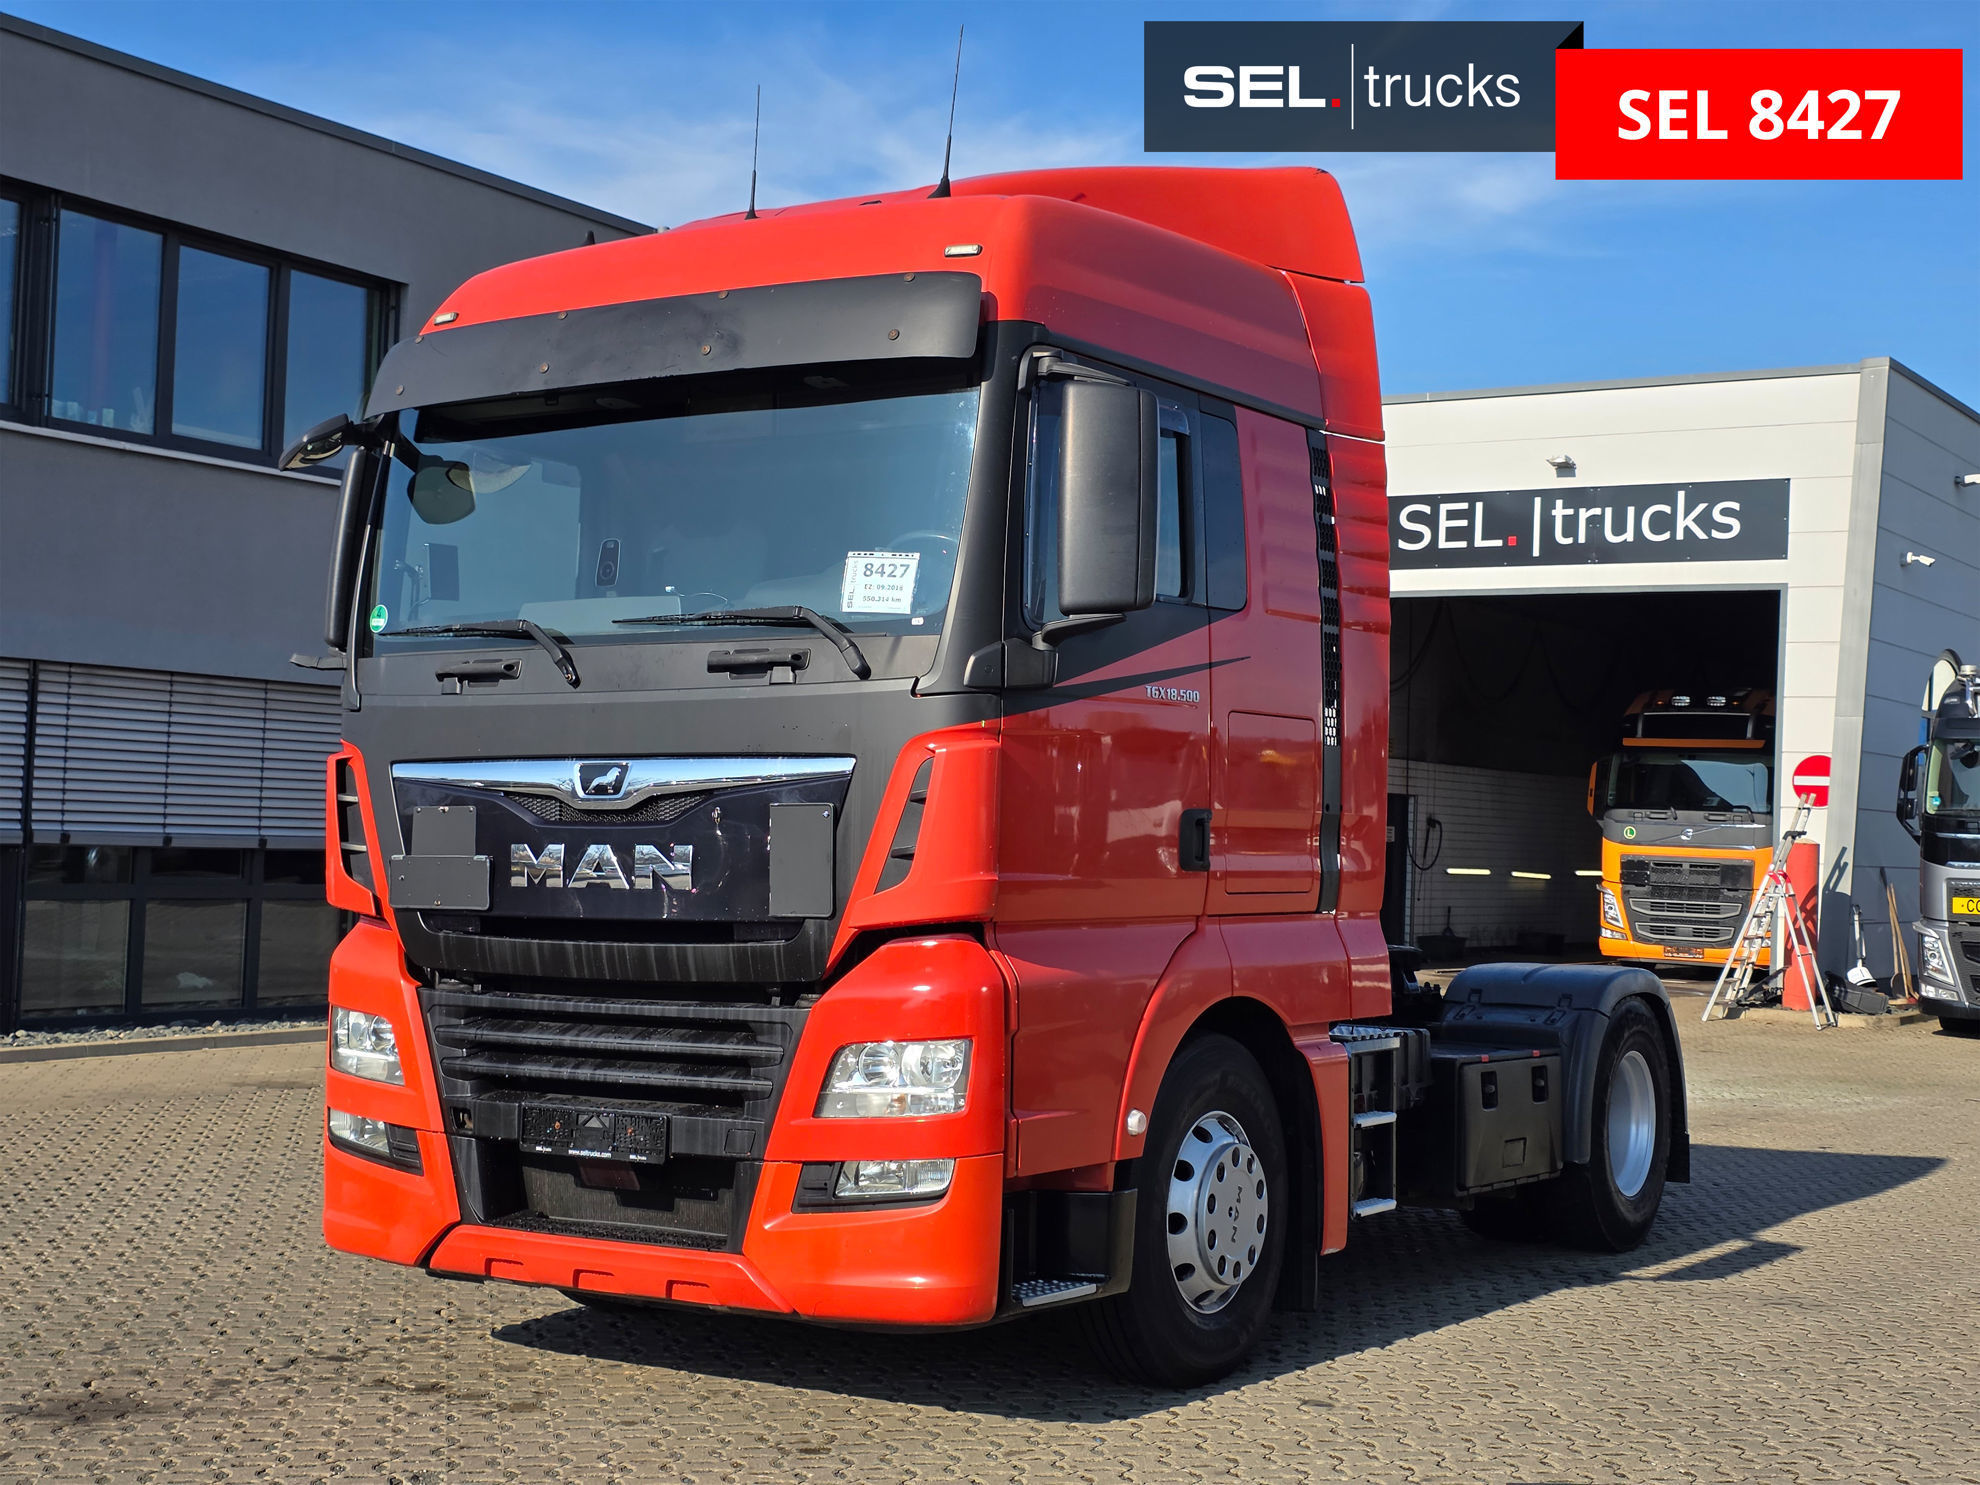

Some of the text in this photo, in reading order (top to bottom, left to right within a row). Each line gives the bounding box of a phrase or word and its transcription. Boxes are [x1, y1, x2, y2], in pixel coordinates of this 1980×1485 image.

[1552, 490, 1742, 545] trucks
[863, 562, 911, 578] 8427
[510, 843, 694, 890] MAN
[1230, 1186, 1243, 1243] MAN
